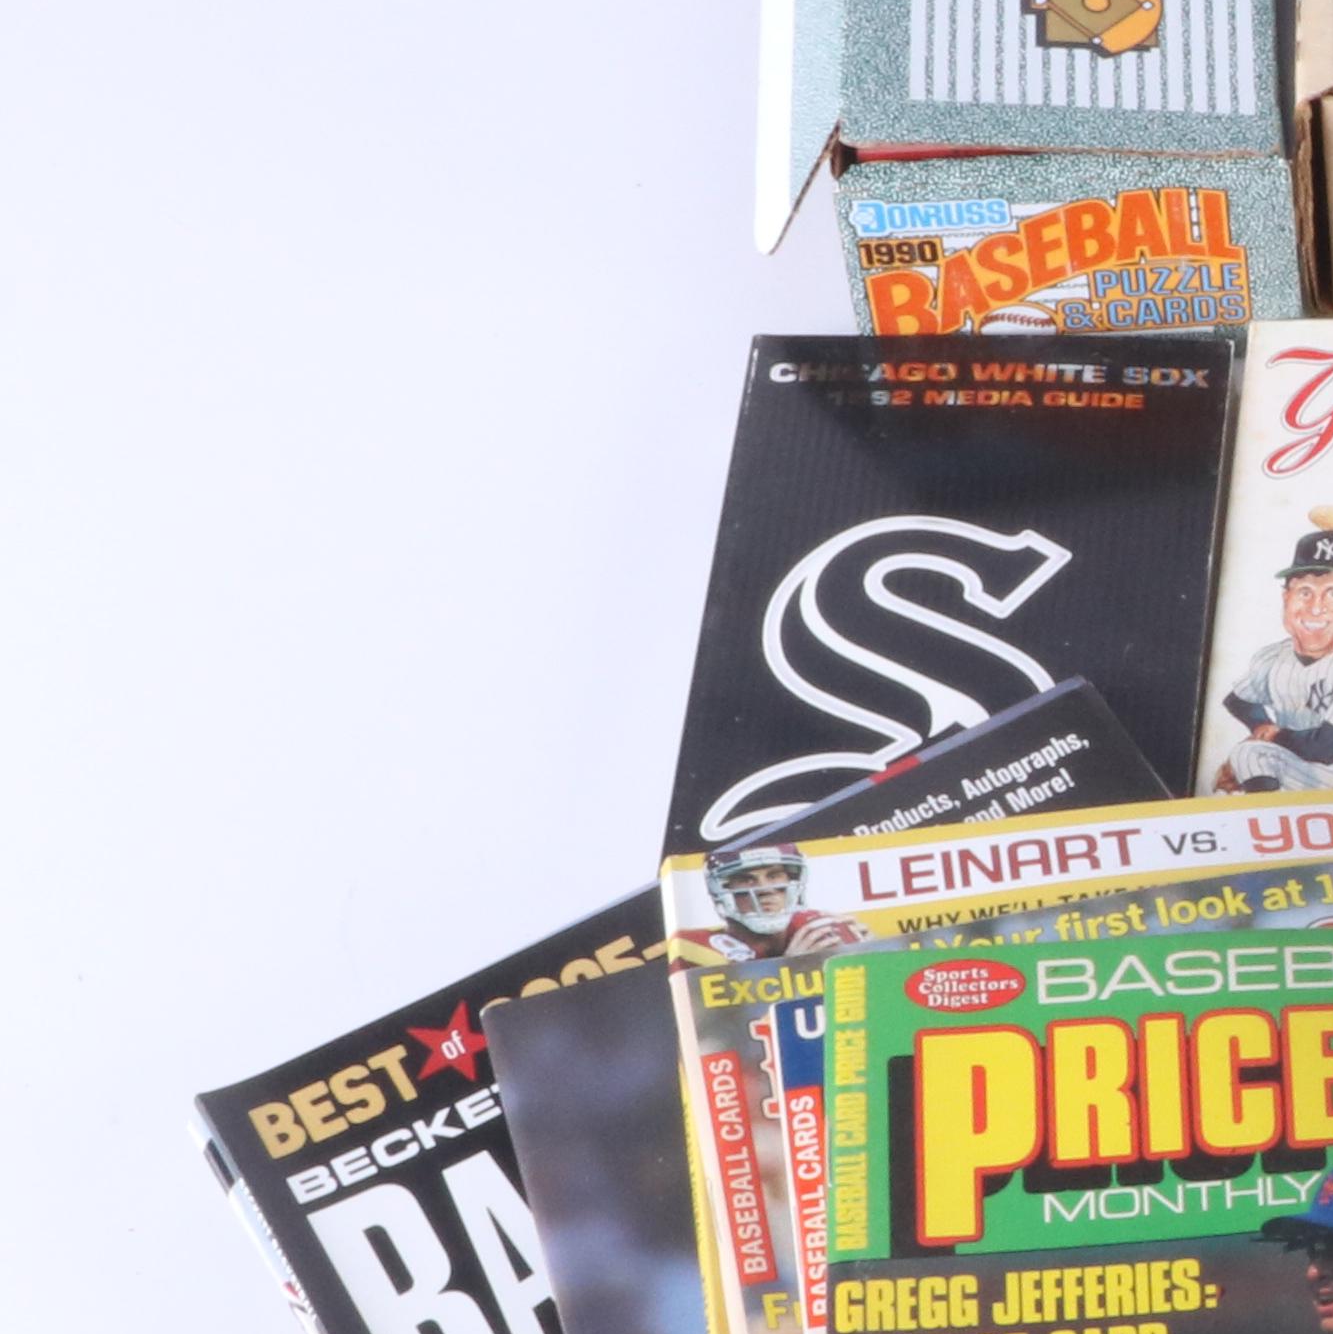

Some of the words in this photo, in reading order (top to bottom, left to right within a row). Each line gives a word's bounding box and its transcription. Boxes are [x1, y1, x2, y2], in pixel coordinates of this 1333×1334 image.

[852, 199, 1010, 234] DONRUSS
[859, 239, 940, 267] 1990
[863, 186, 1247, 335] BASEBALL
[1095, 263, 1243, 298] PUZZLE
[1061, 301, 1095, 329] &
[1103, 293, 1248, 328] CARDS
[768, 362, 957, 383] CHAGO
[973, 363, 1107, 384] WHITE
[1122, 366, 1210, 388] SOX
[923, 389, 1032, 407] MEDIA
[1042, 391, 1144, 409] GUIDE
[960, 731, 1091, 801] Autographs,
[1004, 768, 1076, 814] More!
[858, 827, 1141, 902] LEINART
[897, 910, 961, 935] WHY
[1054, 900, 1148, 943] first
[1154, 885, 1253, 925] look
[1262, 879, 1307, 912] at
[833, 965, 866, 1024] GUIDE
[918, 978, 1018, 995] Collectors
[923, 968, 989, 985] Sports
[928, 992, 989, 1008] Digest
[833, 1028, 867, 1086] PRICE
[248, 1044, 419, 1160] BEST
[441, 1030, 467, 1061] of
[709, 1057, 746, 1142] CARDS
[833, 1091, 868, 1148] CARD
[285, 1081, 504, 1205] BECKE
[789, 1094, 823, 1181] CARDS
[725, 1146, 768, 1276] BASEBALL
[833, 1152, 868, 1251] BASEBALL
[1042, 1172, 1324, 1224] MONTHLY
[834, 1274, 980, 1334] GREGG
[992, 1258, 1219, 1326] JEFFERIES:
